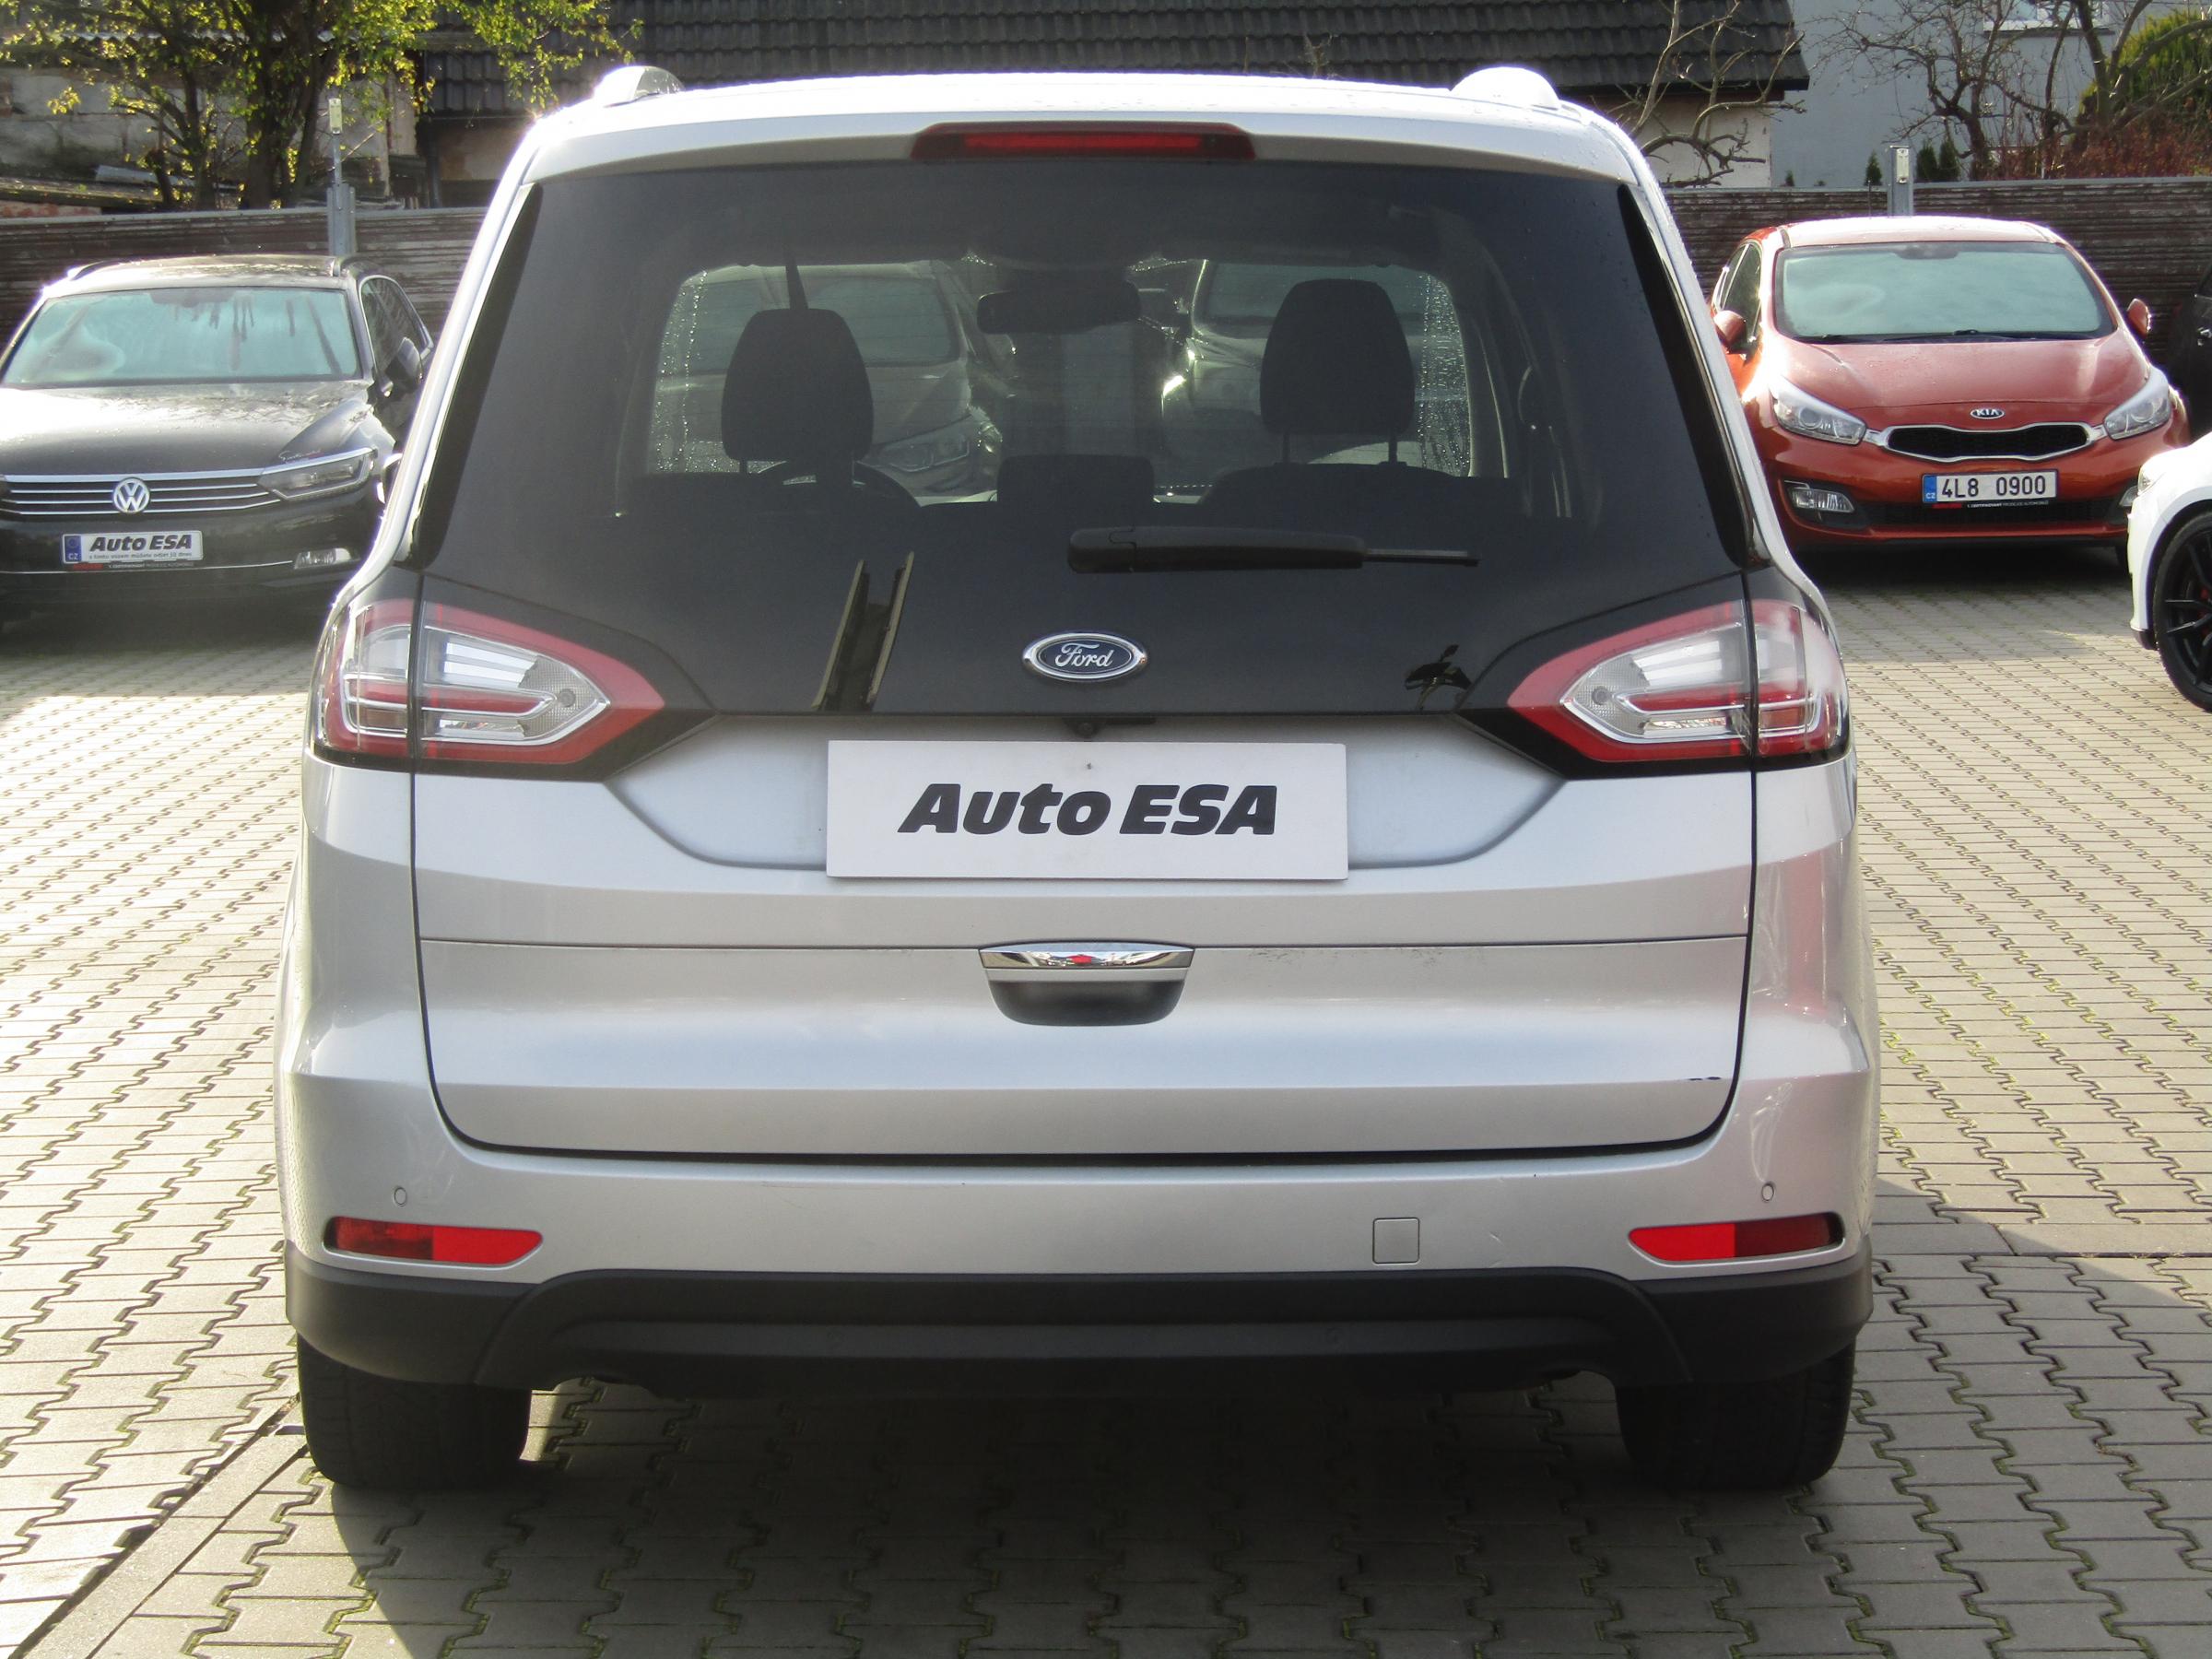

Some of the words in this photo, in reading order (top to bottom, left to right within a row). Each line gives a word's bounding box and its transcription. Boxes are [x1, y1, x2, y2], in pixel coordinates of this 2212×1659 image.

[1941, 477, 1979, 499] 4L8
[1995, 475, 2046, 497] 0900
[89, 535, 147, 552] Auto
[148, 534, 193, 551] ESA
[67, 553, 79, 561] CZ
[1054, 642, 1115, 668] Ford
[897, 782, 1112, 836] Auto
[1119, 783, 1278, 836] ESA
